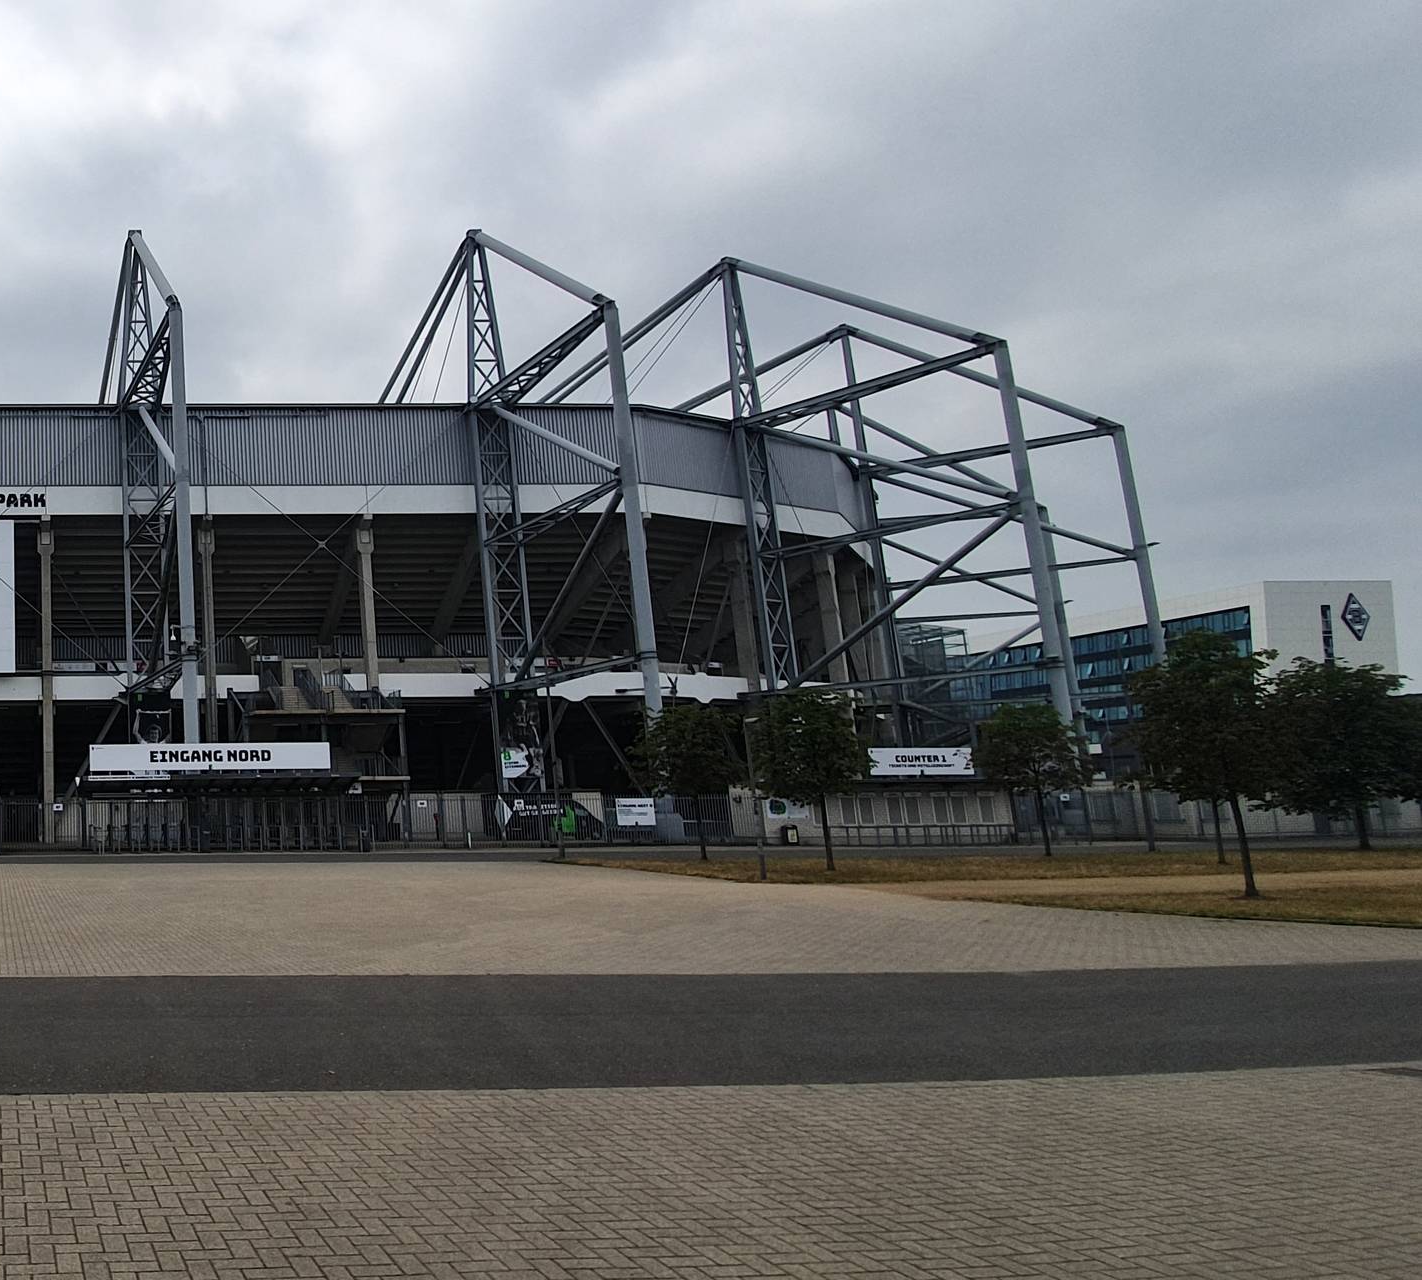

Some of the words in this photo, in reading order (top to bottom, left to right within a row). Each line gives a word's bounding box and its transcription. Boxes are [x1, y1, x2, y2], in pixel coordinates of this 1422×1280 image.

[149, 750, 224, 763] EINGANG
[227, 749, 272, 762] NORD
[895, 754, 940, 763] COUNTER
[941, 754, 947, 763] 1
